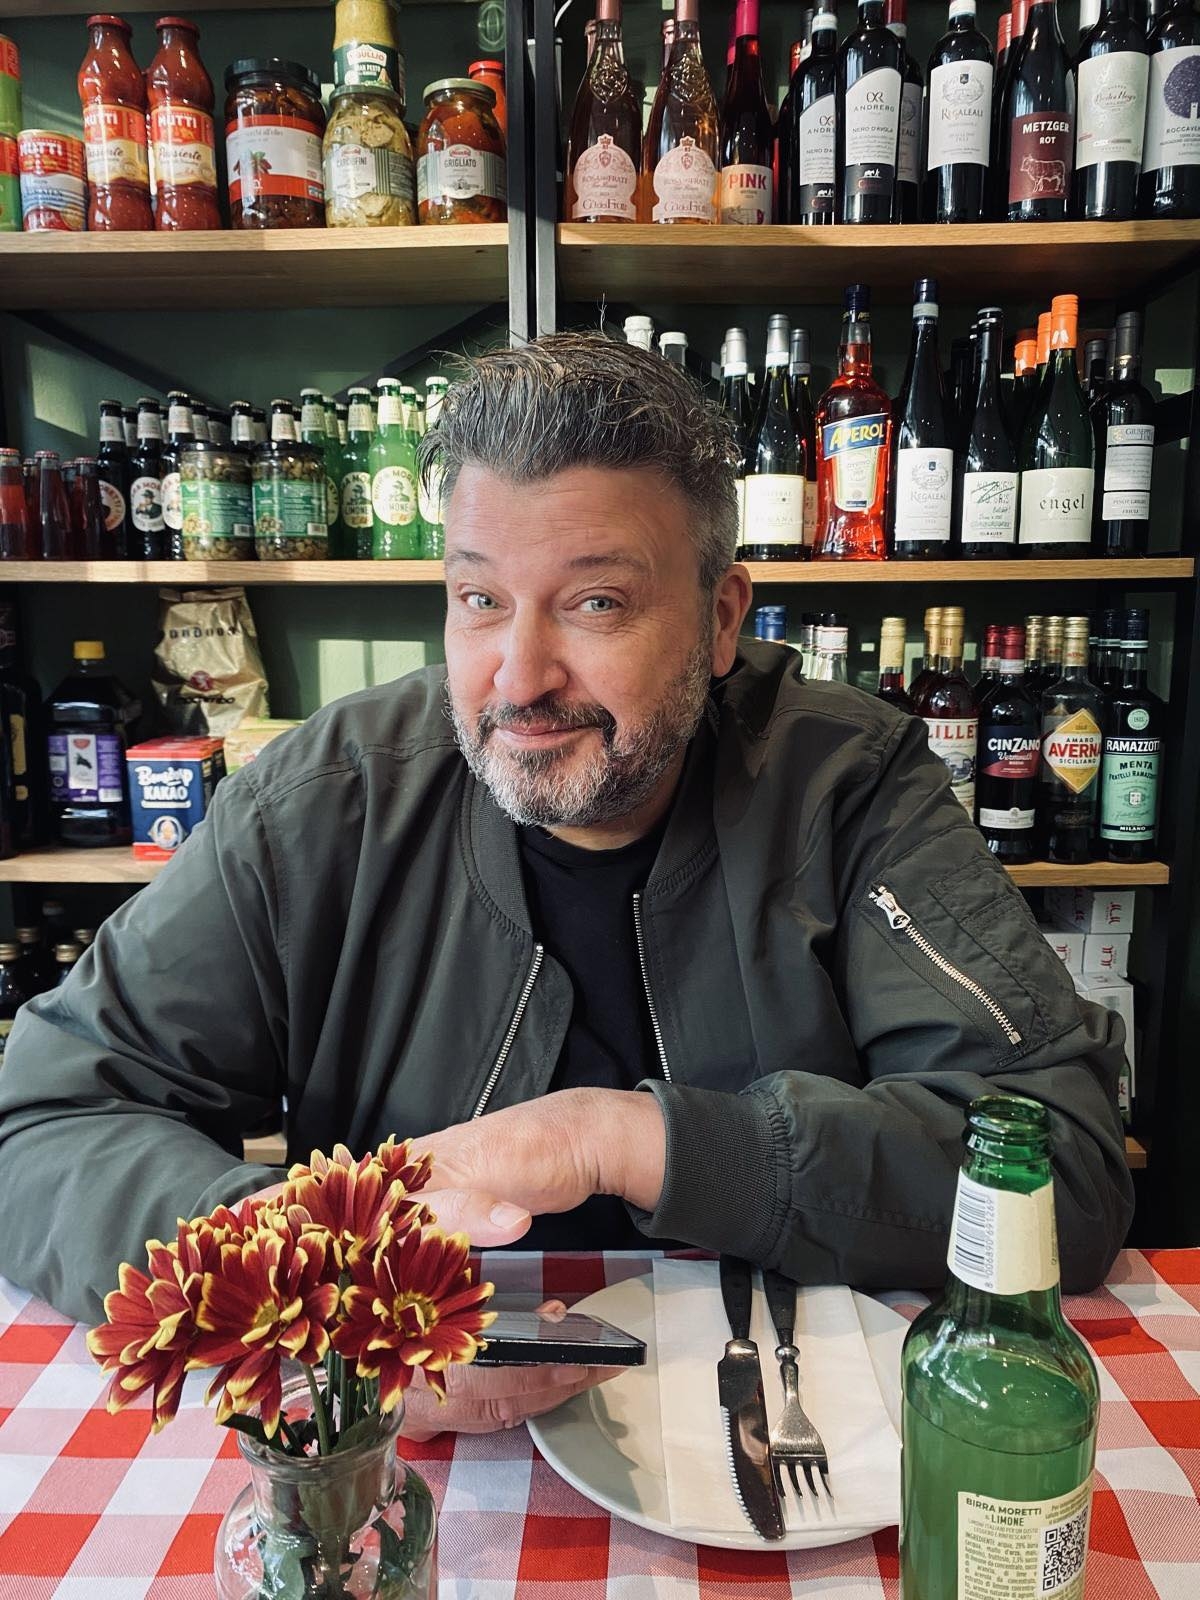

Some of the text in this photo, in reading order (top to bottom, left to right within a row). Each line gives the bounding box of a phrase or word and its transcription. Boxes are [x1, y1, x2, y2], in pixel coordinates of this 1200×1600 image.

[158, 113, 198, 129] MUTTI
[1022, 121, 1069, 134] METZGER
[1039, 136, 1056, 144] ROT
[20, 141, 63, 157] MUTTI
[444, 158, 477, 169] GRIGLIATO
[728, 173, 767, 190] PINK
[830, 422, 885, 451] APEROL
[1039, 493, 1085, 514] engel
[988, 737, 1041, 753] CINZANO
[1119, 760, 1153, 771] MENTA
[1108, 771, 1131, 781] FRATELLI
[143, 785, 188, 801] KAKAO
[965, 1497, 1042, 1517] BIRRA MORETTI
[991, 1514, 1025, 1527] LIMONE
